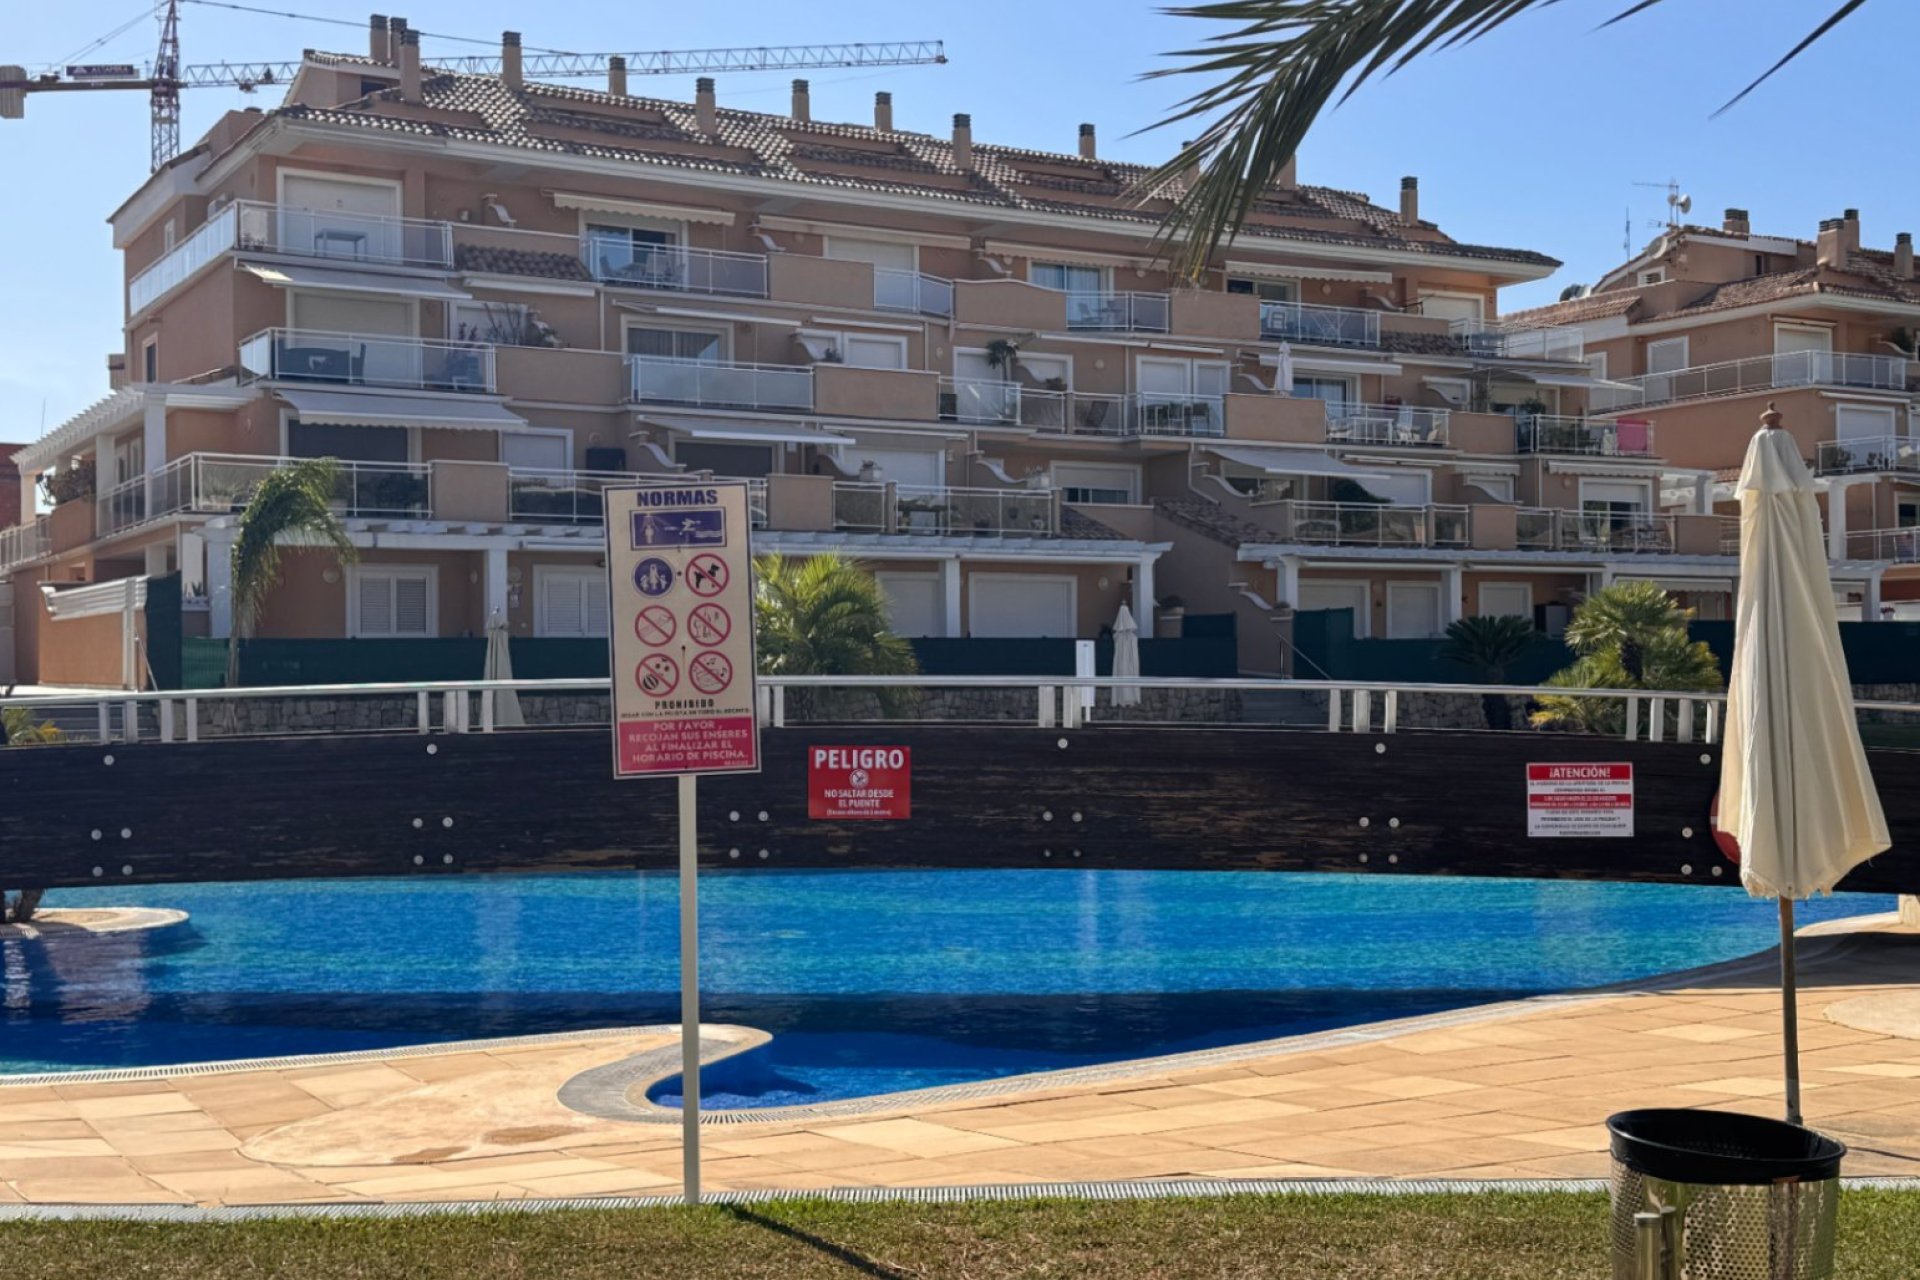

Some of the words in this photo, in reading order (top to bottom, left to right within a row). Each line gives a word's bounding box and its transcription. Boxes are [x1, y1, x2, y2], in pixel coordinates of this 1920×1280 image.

[637, 489, 718, 506] NORMAS
[655, 698, 714, 710] PROHIBIDO
[654, 722, 676, 732] POR
[629, 733, 678, 743] RECOJAN
[681, 732, 700, 740] SUS
[703, 730, 748, 739] ENSERES
[645, 744, 659, 752] AL
[661, 741, 718, 752] FINALIZAR
[721, 740, 732, 748] EL
[632, 752, 684, 763] HORARIO
[686, 751, 699, 760] DE
[815, 749, 904, 769] PELIGRO
[824, 789, 838, 798] NO
[838, 789, 866, 798] SALTAR
[868, 789, 894, 798] DESDE
[838, 799, 848, 808] EL
[848, 799, 880, 808] PUENTE
